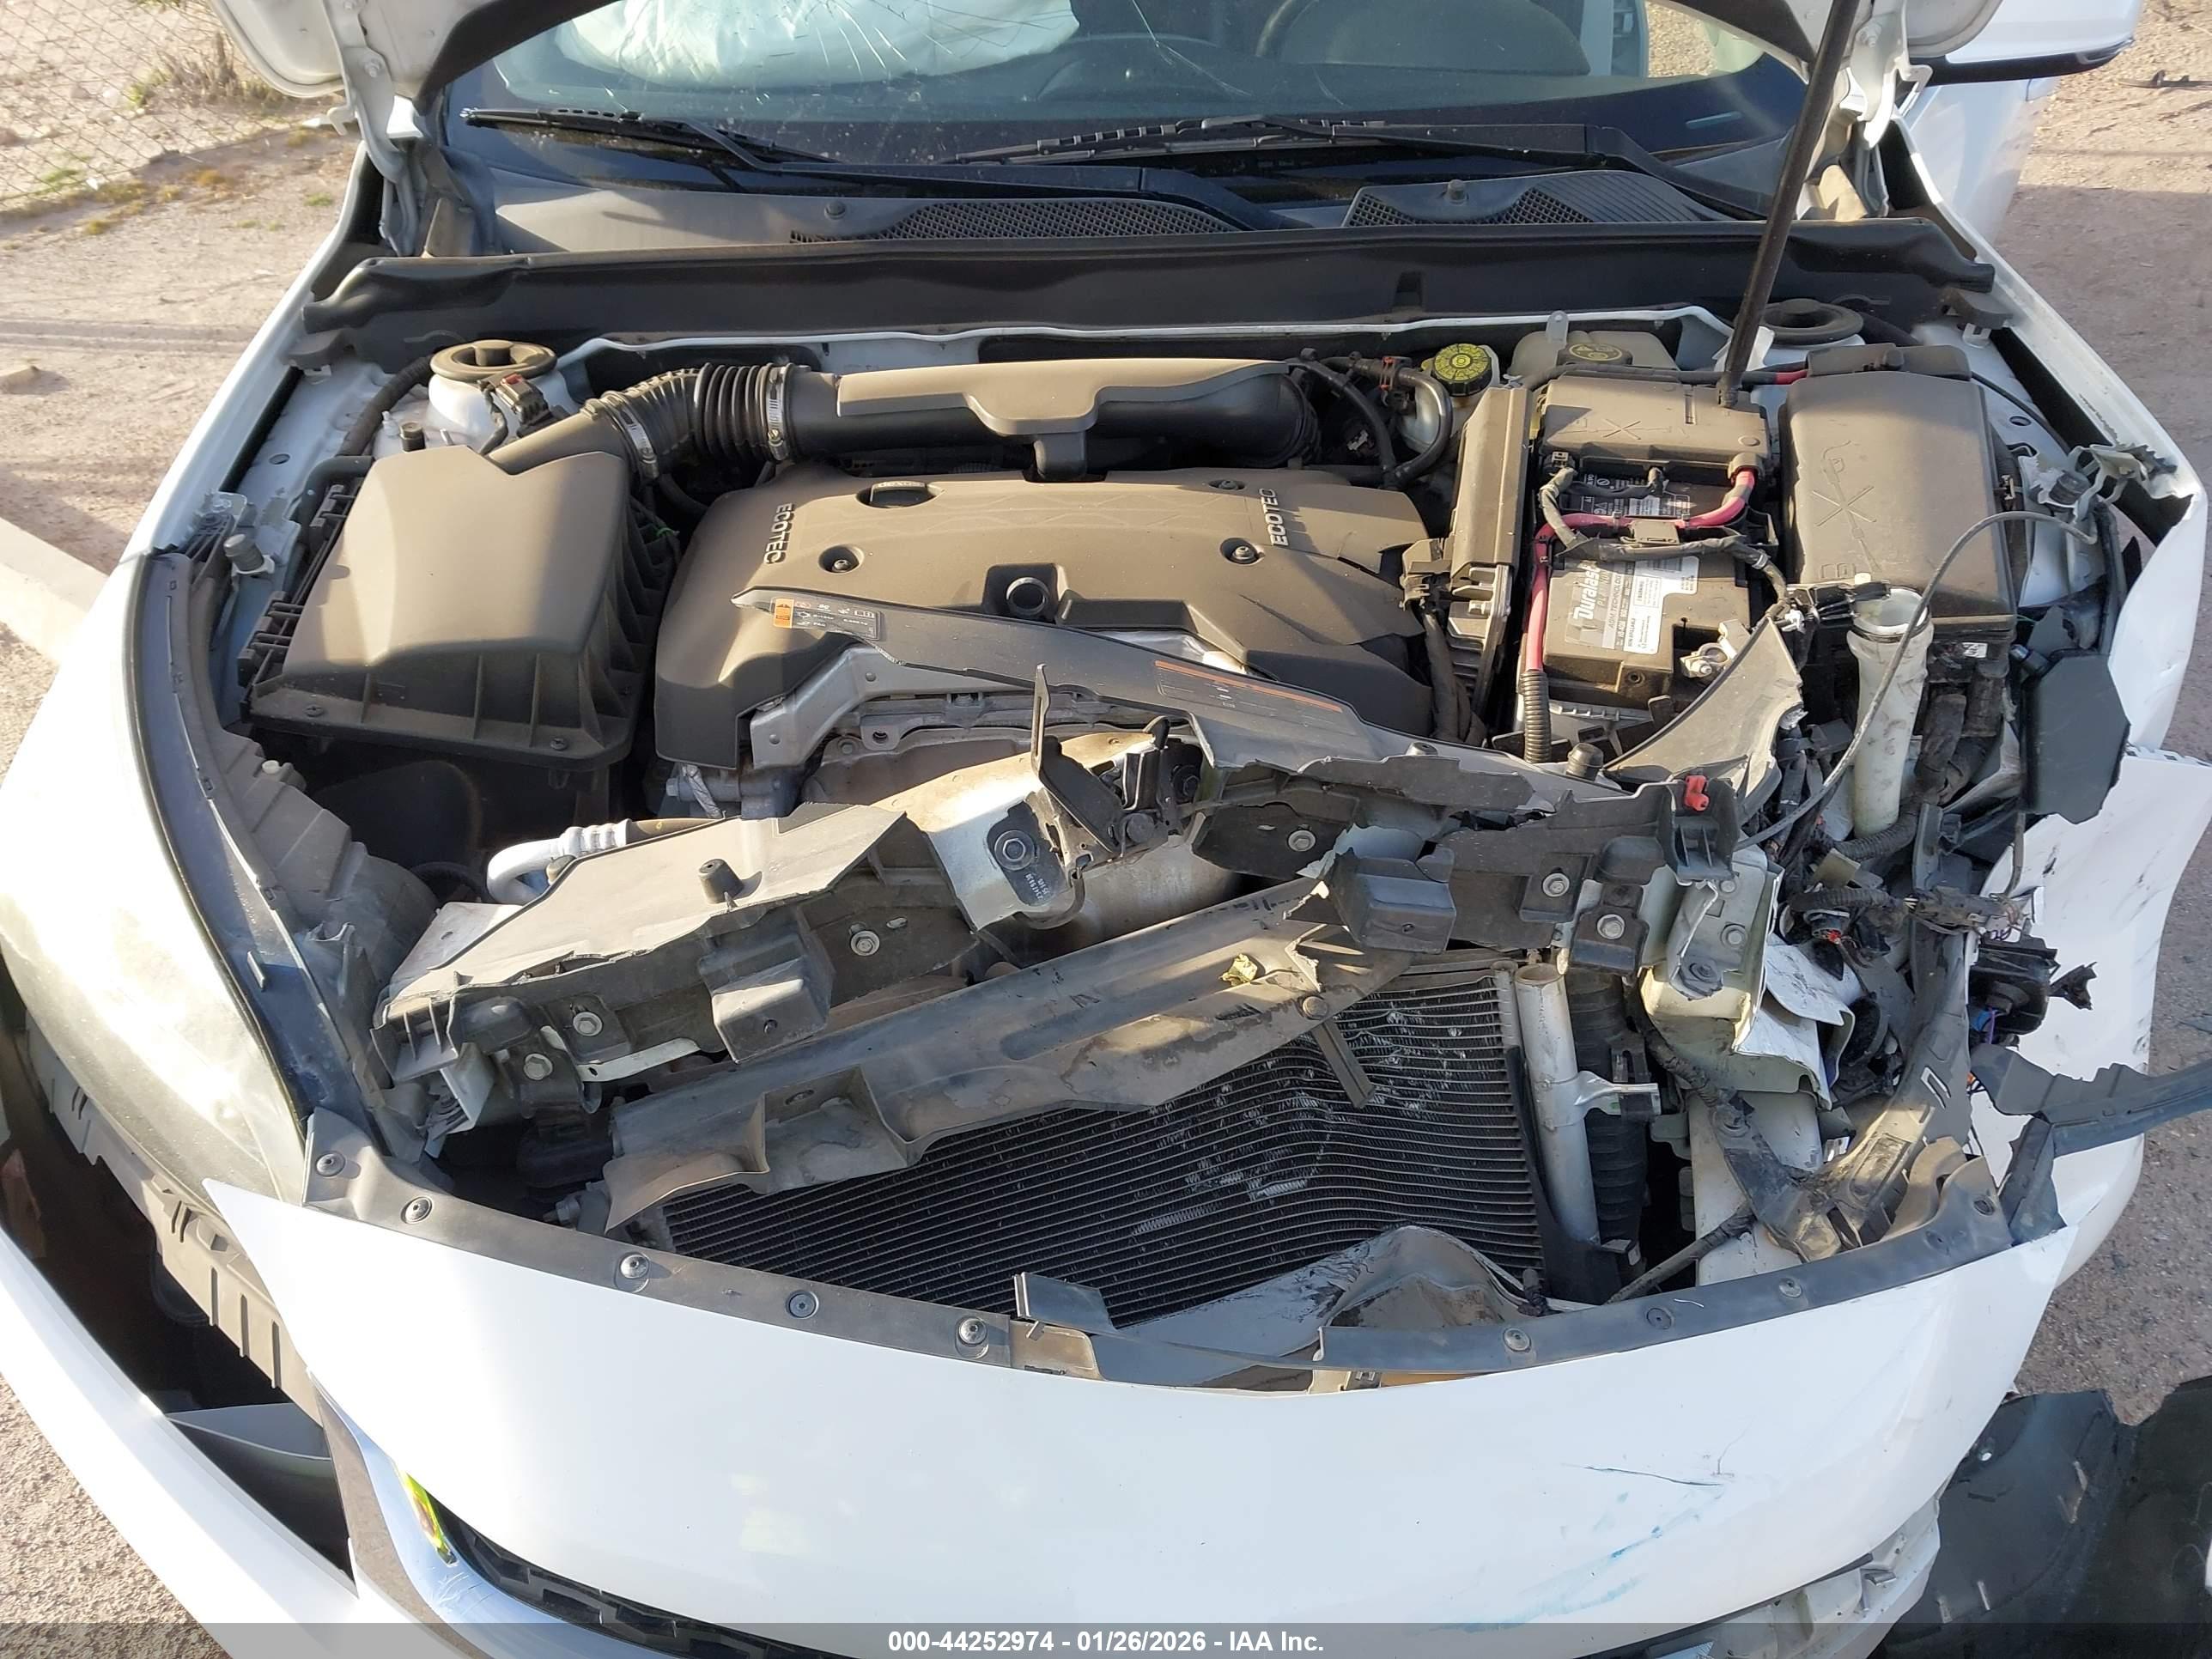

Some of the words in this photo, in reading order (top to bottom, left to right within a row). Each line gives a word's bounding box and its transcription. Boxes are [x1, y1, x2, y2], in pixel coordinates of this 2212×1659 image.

[763, 502, 793, 564] ECOTEC
[1259, 489, 1288, 545] ECOTEC
[1573, 562, 1601, 619] Duralast
[1611, 574, 1622, 611] TECHNOLOG
